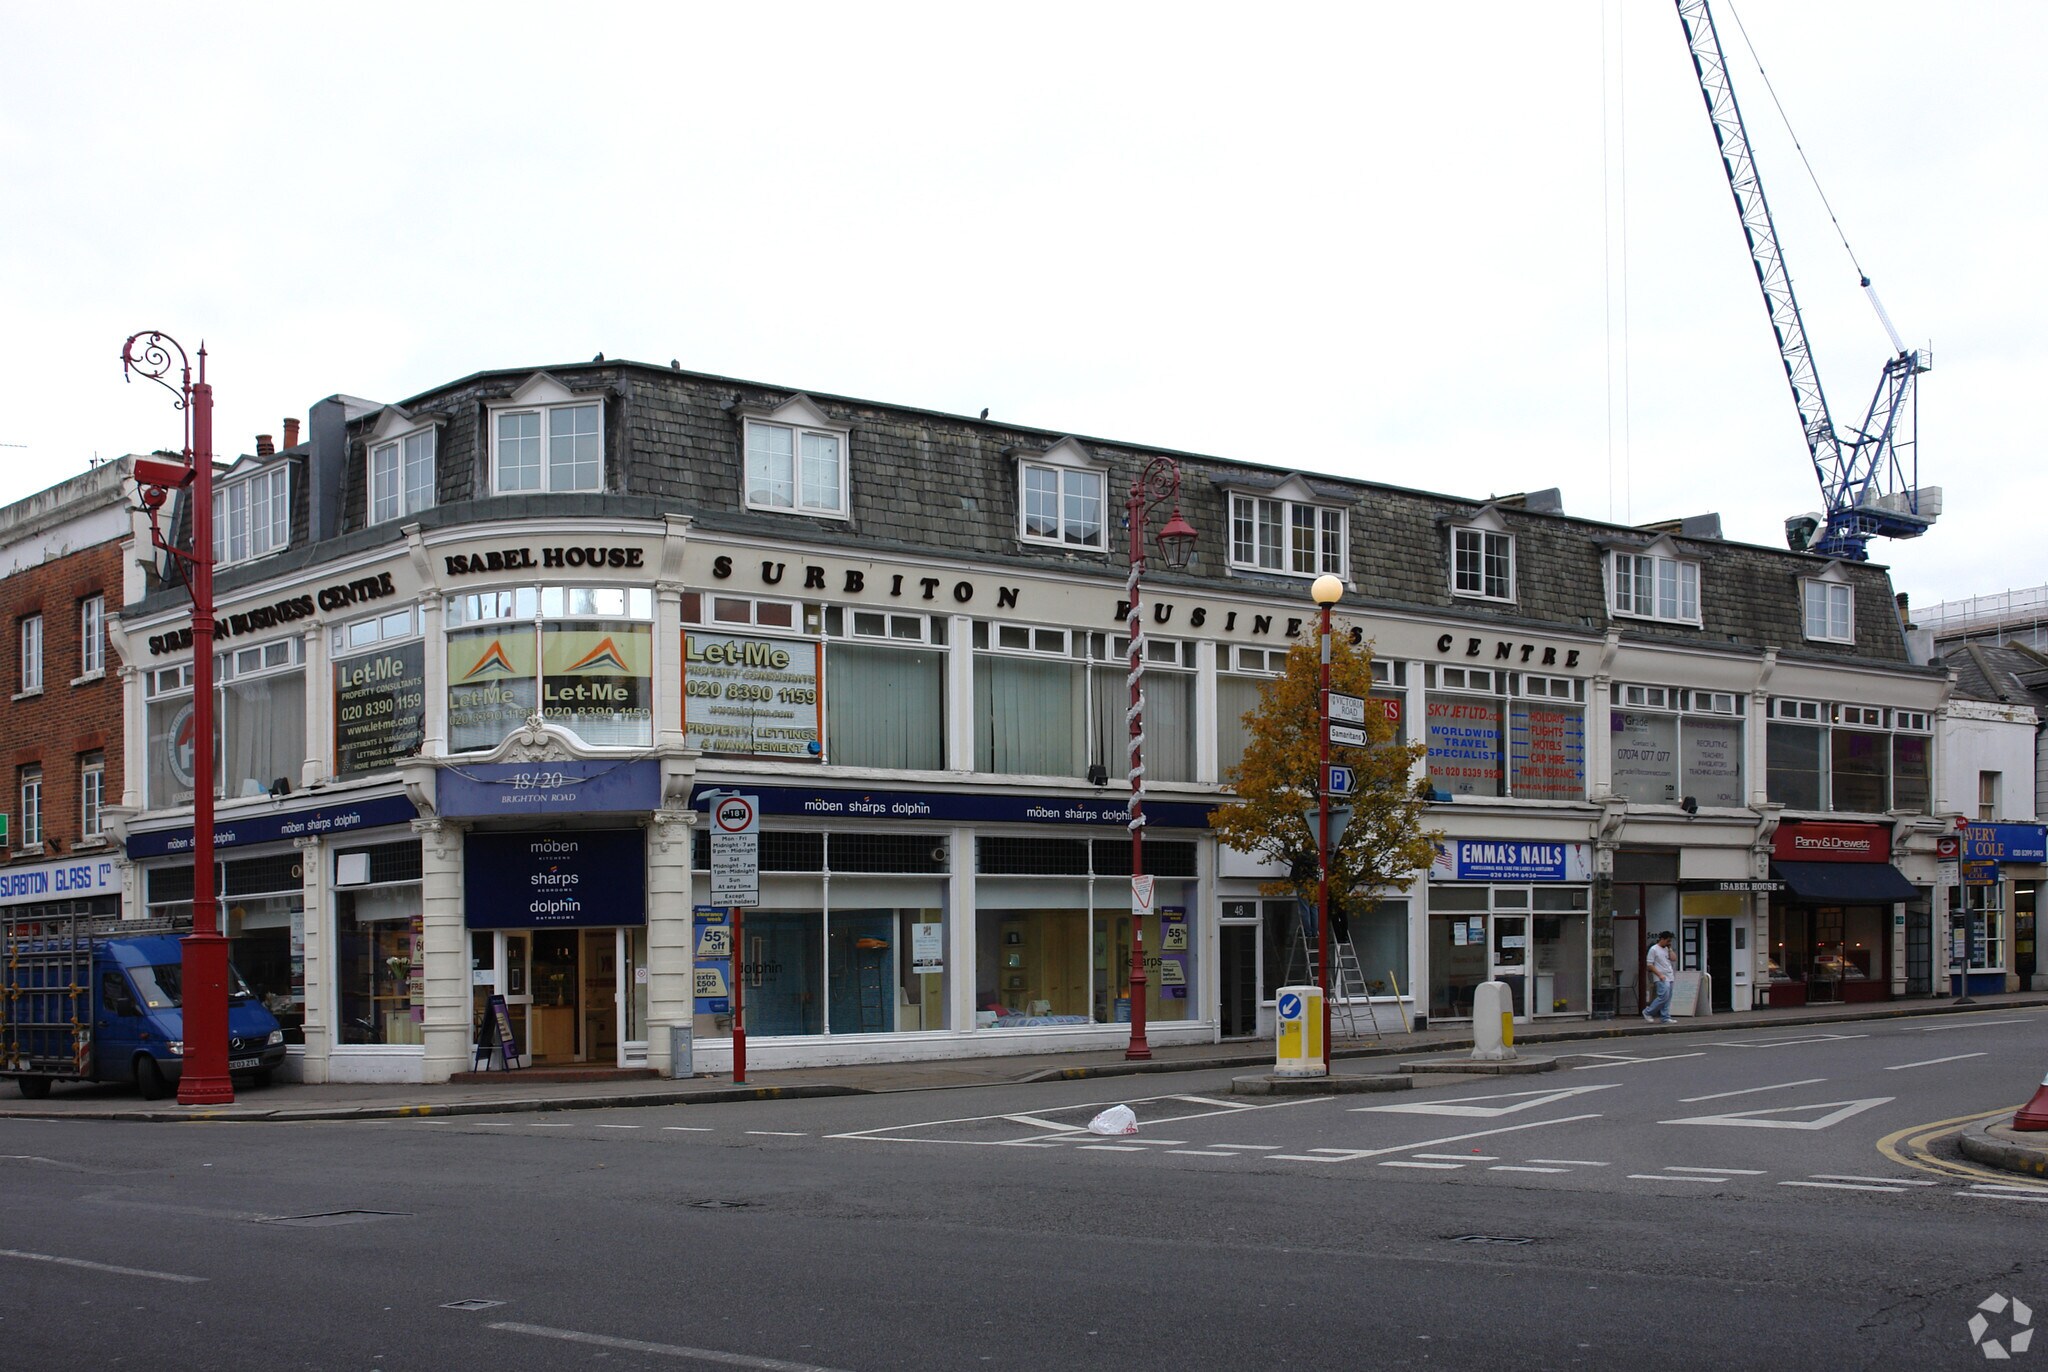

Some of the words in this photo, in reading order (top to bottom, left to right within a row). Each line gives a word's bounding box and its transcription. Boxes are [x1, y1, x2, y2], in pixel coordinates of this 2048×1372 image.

[444, 547, 537, 576] ISABEL
[543, 547, 644, 568] HOUSE
[229, 594, 316, 636] BUSINESS
[318, 571, 396, 611] CENTRE
[712, 555, 1020, 608] SURBITON
[1114, 600, 1364, 645] BUSINES
[1436, 633, 1581, 668] CENTRE
[686, 635, 790, 669] Let-Me
[341, 656, 403, 688] Let-Me
[686, 665, 740, 679] PROPERTY
[341, 687, 375, 700] PROPERTY
[376, 676, 422, 694] CONSULTANTS
[544, 683, 629, 701] Let-Me
[686, 679, 722, 697] 020
[727, 682, 773, 701] 8390
[779, 686, 817, 705] 1159
[449, 686, 514, 710] Let-Me
[1335, 695, 1363, 709] VICTORIA
[341, 705, 362, 721] 020
[365, 698, 393, 717] 8390
[397, 692, 421, 710] 1159
[544, 706, 572, 718] 020
[577, 706, 614, 718] 8390
[619, 707, 650, 720] 1159
[1341, 706, 1358, 717] ROAD
[1428, 703, 1449, 717] SKY
[1450, 704, 1469, 719] JET
[449, 713, 469, 726] 020
[472, 710, 502, 724] 8390
[1530, 711, 1565, 724] HOLIDAYS
[347, 715, 416, 736] www.let-me.com
[686, 722, 754, 738] PROPERTY
[757, 726, 817, 741] LETTINGS
[1431, 725, 1504, 739] WORLDWIDE
[1531, 725, 1564, 738] FLIGHTS
[1331, 729, 1362, 741] Samaritans
[714, 739, 803, 753] MANAGEMENT
[1444, 737, 1488, 749] TRAVEL
[1532, 740, 1562, 751] HOTELS
[1696, 739, 1728, 749] RECRUITING
[356, 748, 382, 759] LETTINGS
[1428, 748, 1504, 761] SPECIALISTS
[1530, 752, 1547, 764] CAR
[1548, 754, 1566, 765] HIRE
[1617, 748, 1638, 760] 07074
[1641, 750, 1655, 761] 077
[1657, 751, 1671, 762] 077
[1702, 751, 1724, 759] TEACHERS
[1429, 765, 1443, 776] Tel:
[1445, 766, 1460, 777] 020
[1462, 767, 1482, 778] 8339
[1520, 766, 1541, 777] TRAVEL
[1542, 767, 1576, 779] INSURANCE
[512, 771, 563, 790] 18/20
[1333, 772, 1343, 788] P
[501, 794, 547, 804] BRIGHTON
[551, 793, 577, 801] ROAD
[804, 798, 843, 811] möben
[848, 801, 886, 815] sharps
[892, 802, 931, 816] dolphin
[1026, 806, 1060, 818] möben
[1064, 808, 1098, 821] sharps
[280, 821, 305, 834] möben
[307, 816, 331, 834] sharps
[334, 813, 360, 828] dolphin
[213, 830, 235, 844] dolphin
[530, 839, 578, 853] möben
[730, 847, 757, 855] Midnight
[1975, 841, 2005, 857] COLE
[1462, 843, 1517, 864] EMMA'S
[1521, 845, 1562, 865] NAILS
[729, 868, 755, 876] Midnight
[0, 870, 48, 898] SURBITON
[55, 865, 92, 892] GLASS
[530, 872, 579, 887] sharps
[1720, 882, 1750, 891] ISABEL
[1751, 882, 1777, 891] HOUSE
[529, 899, 581, 914] dolphin
[1234, 905, 1244, 916] 48
[711, 942, 725, 950] off
